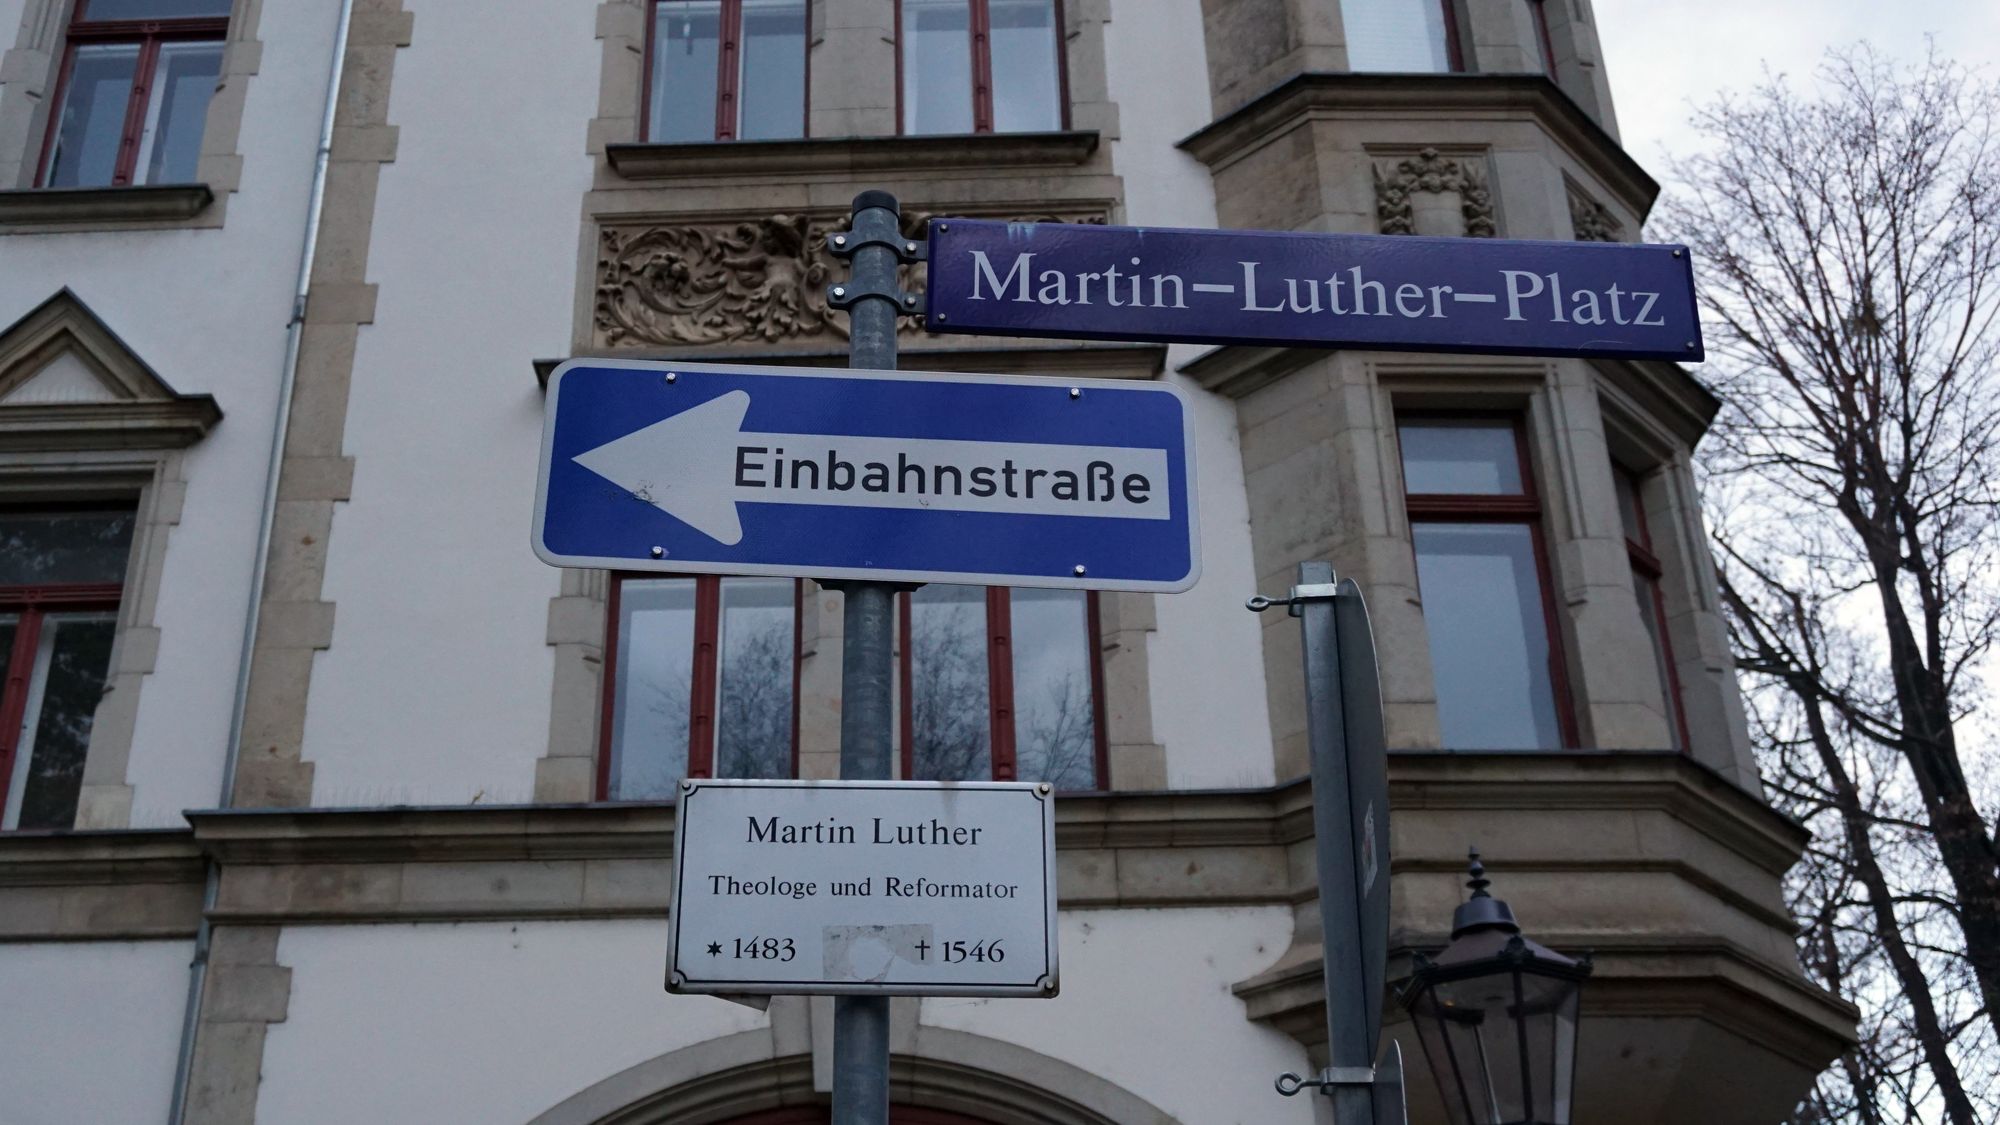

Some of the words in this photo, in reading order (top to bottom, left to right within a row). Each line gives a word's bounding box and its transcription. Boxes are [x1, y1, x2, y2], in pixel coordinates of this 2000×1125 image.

[967, 249, 1666, 326] Martin-Luther-Platz
[734, 445, 1152, 505] Einbahnstraße
[746, 816, 856, 844] Martin
[872, 817, 983, 845] Luther
[708, 875, 817, 899] Theologe
[831, 877, 871, 897] und
[885, 876, 1018, 898] Reformator
[733, 935, 797, 962] 1483
[943, 938, 1005, 964] 1546
